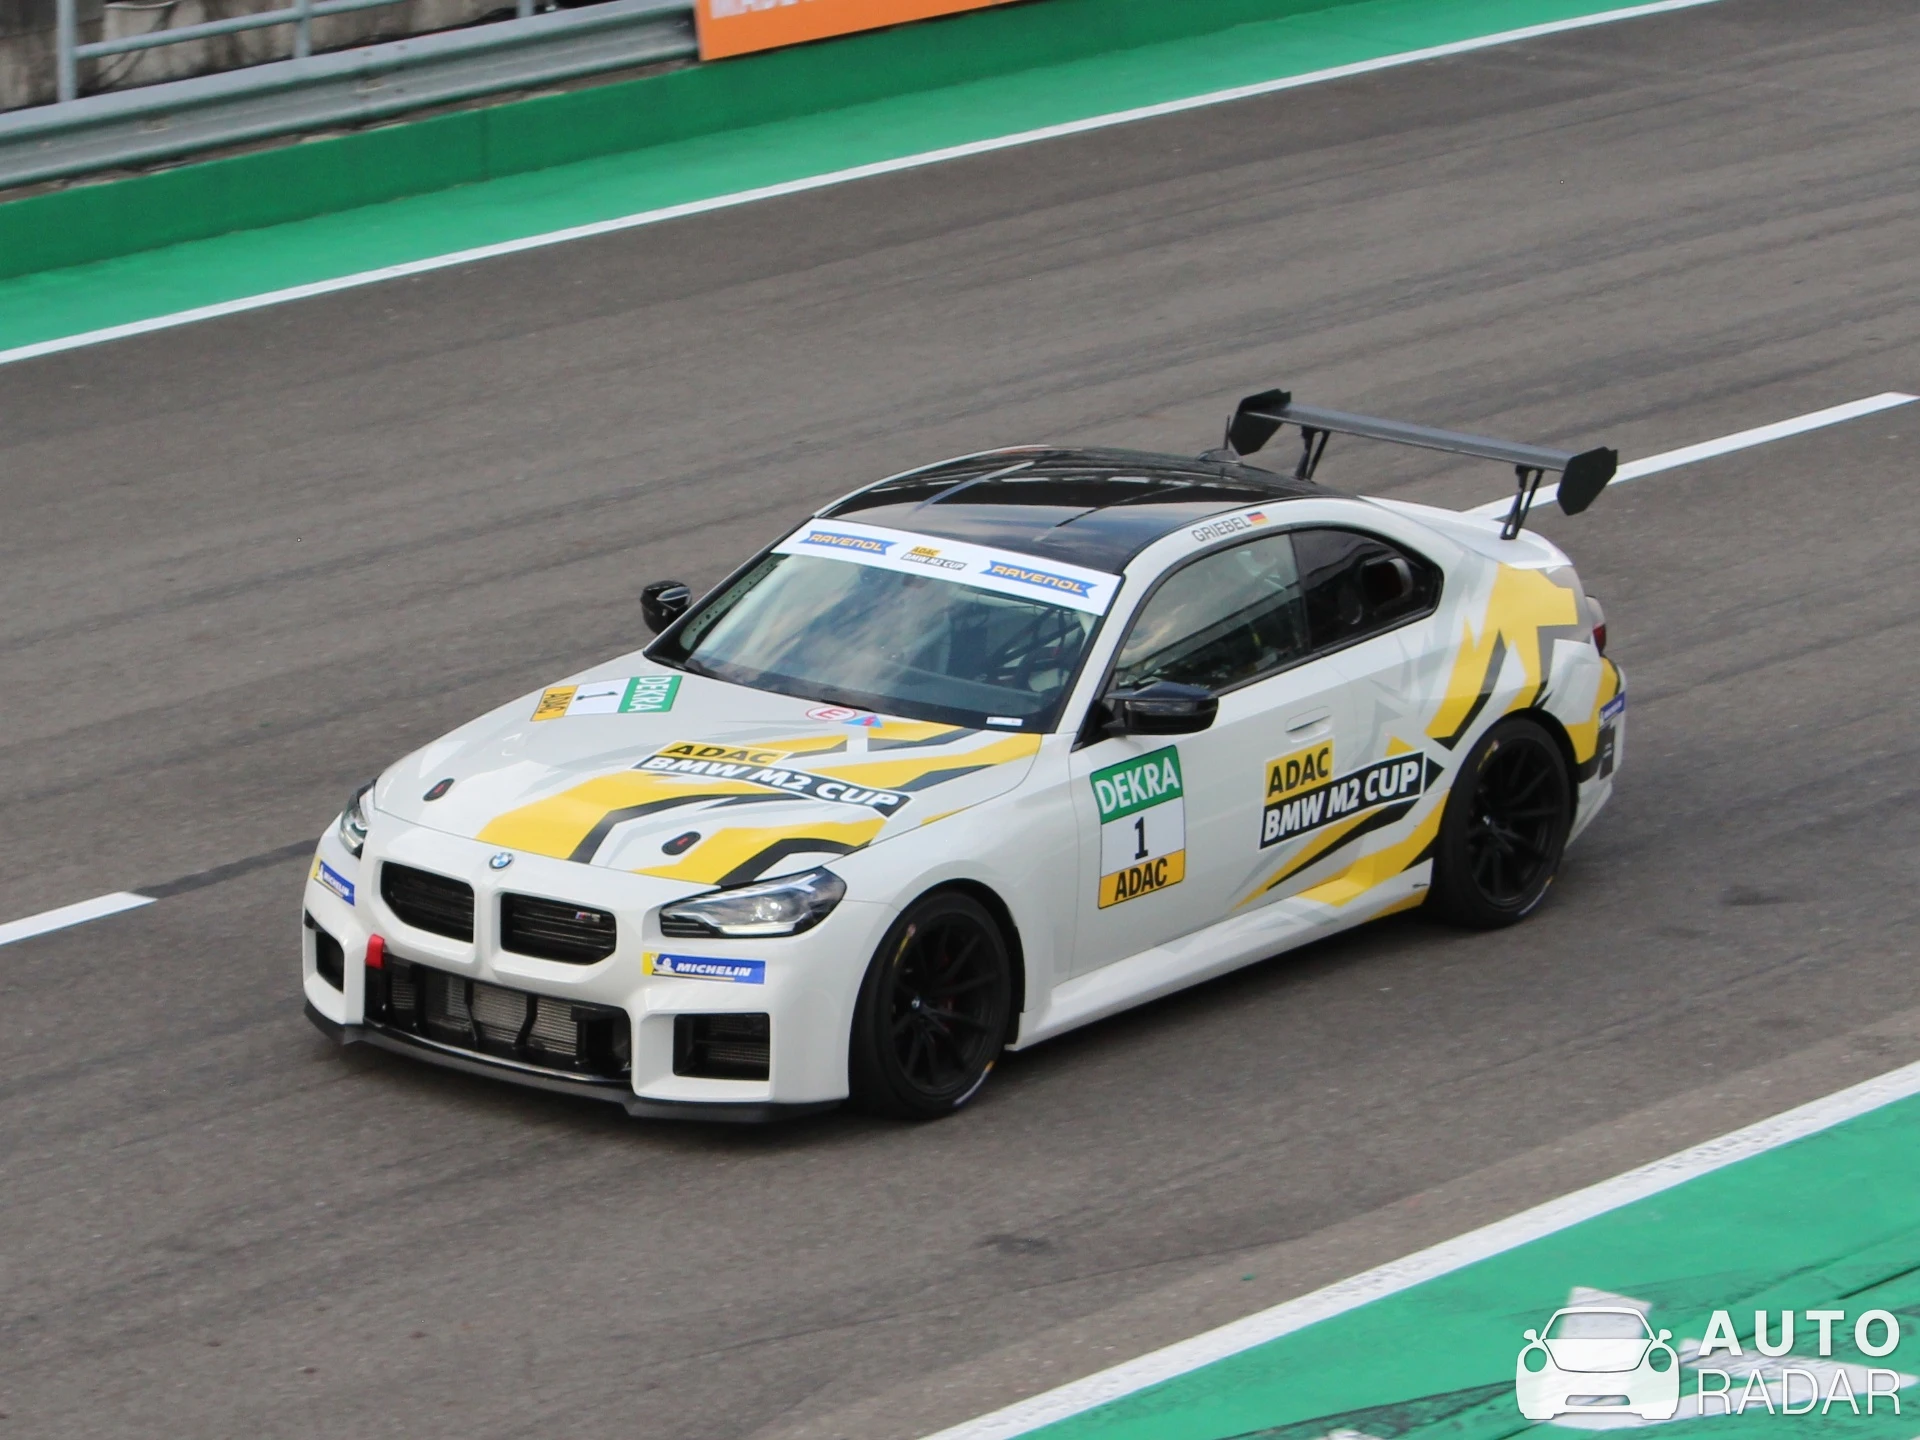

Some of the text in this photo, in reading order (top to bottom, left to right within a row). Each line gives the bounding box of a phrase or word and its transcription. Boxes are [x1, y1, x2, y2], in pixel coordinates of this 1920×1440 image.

[810, 533, 882, 551] RAVENOL
[1191, 517, 1252, 542] GRIEBEL
[992, 565, 1082, 592] RAVENOL
[627, 677, 672, 712] DEKRA
[666, 744, 778, 764] ADAC
[1267, 747, 1329, 798] ADAC
[646, 757, 900, 807] BMW M2 CUP
[1094, 757, 1180, 814] DEKRA
[1263, 760, 1419, 842] BMW M2 CUP
[1134, 816, 1148, 860] 1
[1114, 857, 1168, 902] ADAC
[676, 963, 752, 977] MICHELIN
